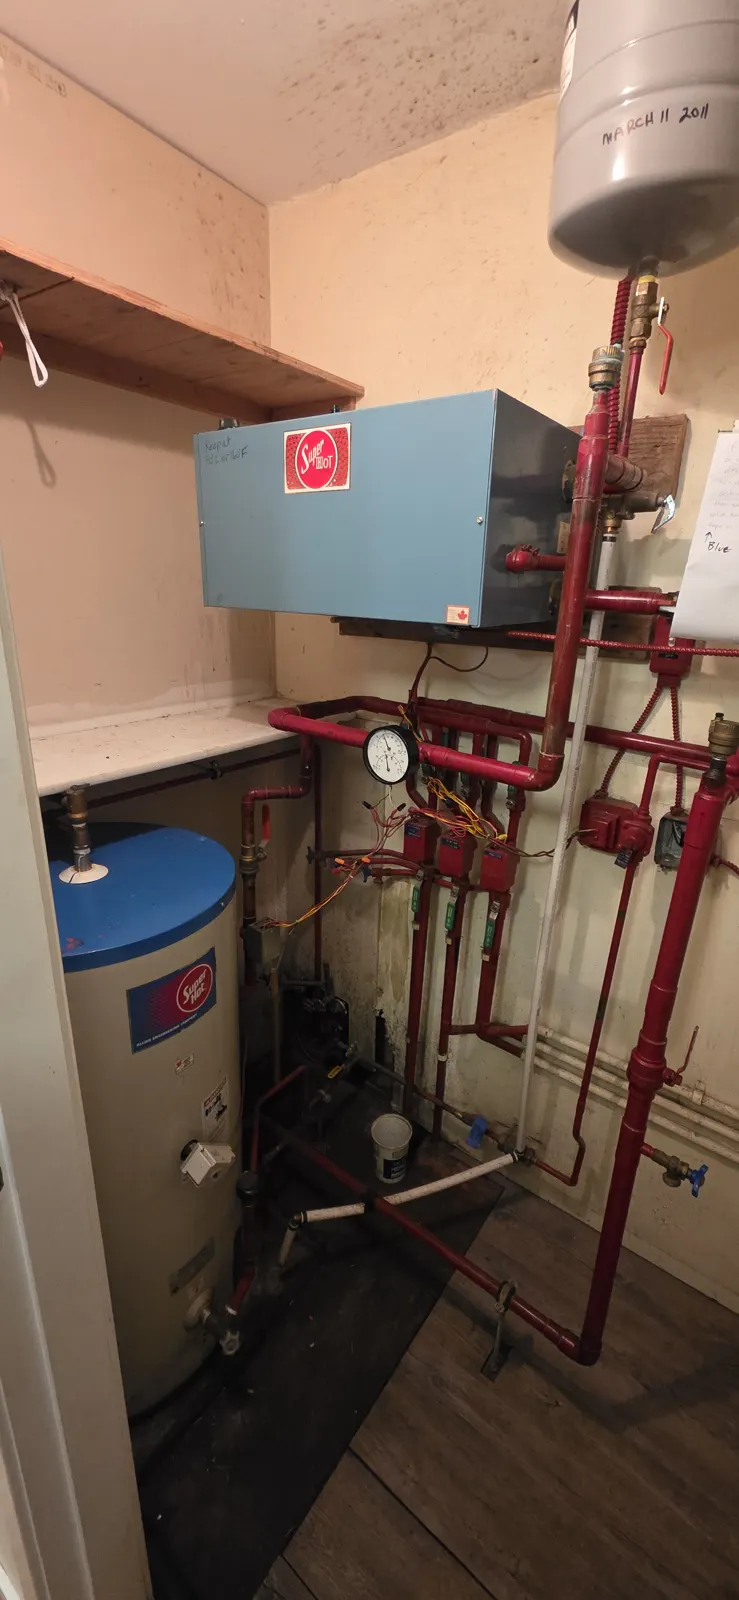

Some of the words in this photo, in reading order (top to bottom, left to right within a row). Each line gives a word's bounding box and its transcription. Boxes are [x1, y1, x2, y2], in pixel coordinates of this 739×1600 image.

[602, 111, 654, 145] MARCH
[660, 107, 670, 123] 11
[678, 102, 709, 123] 2011
[301, 439, 325, 475] Super
[707, 540, 733, 554] Blue
[182, 968, 207, 1005] Super
